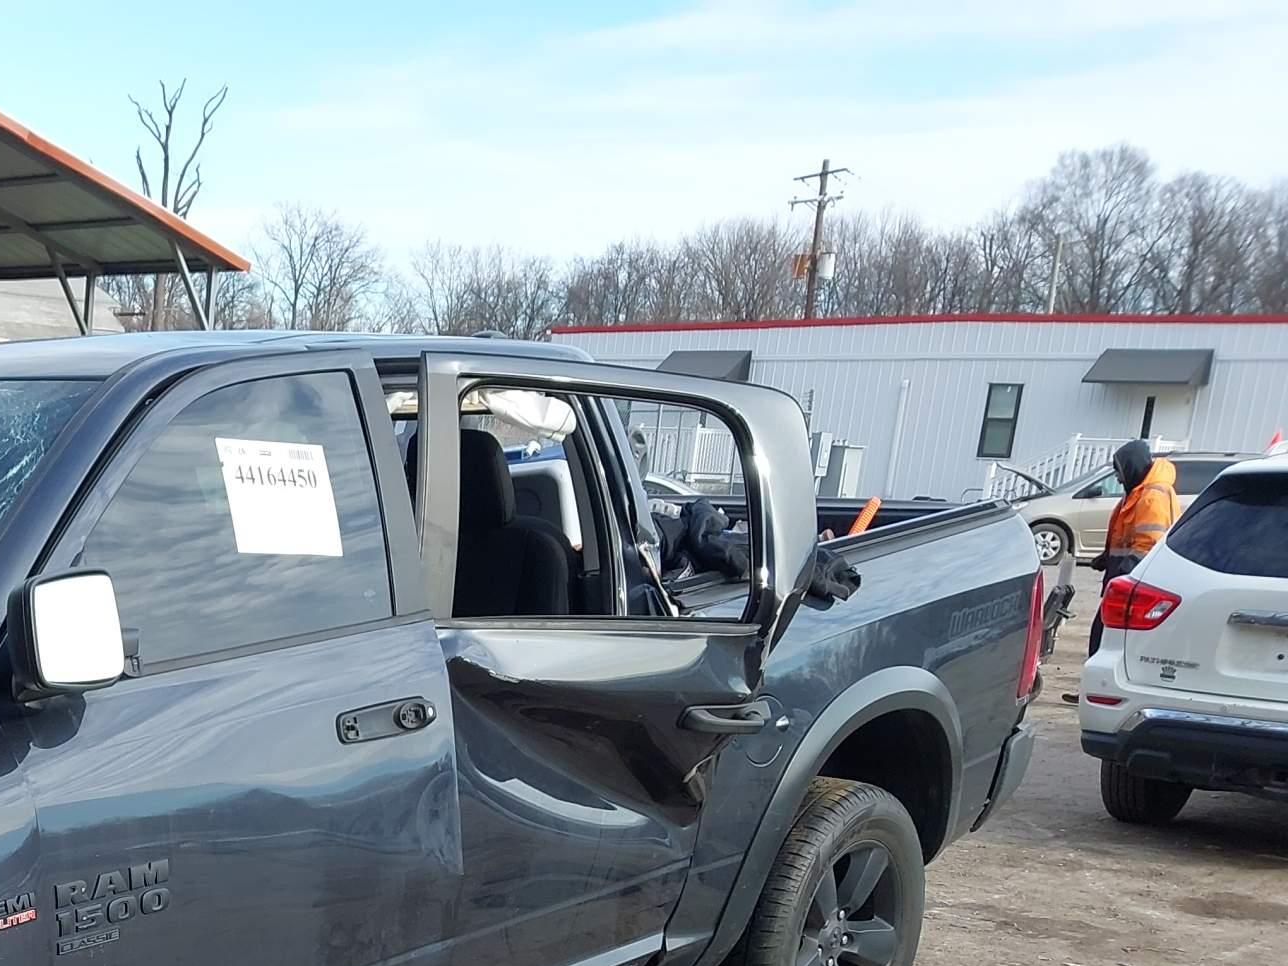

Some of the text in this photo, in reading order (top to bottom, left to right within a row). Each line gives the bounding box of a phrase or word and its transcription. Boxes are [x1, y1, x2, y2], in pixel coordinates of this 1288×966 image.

[235, 465, 317, 488] 44164450
[54, 858, 170, 909] RAM
[0, 909, 36, 930] LITER
[56, 888, 171, 938] 1500
[58, 928, 120, 954] CLASSIC
